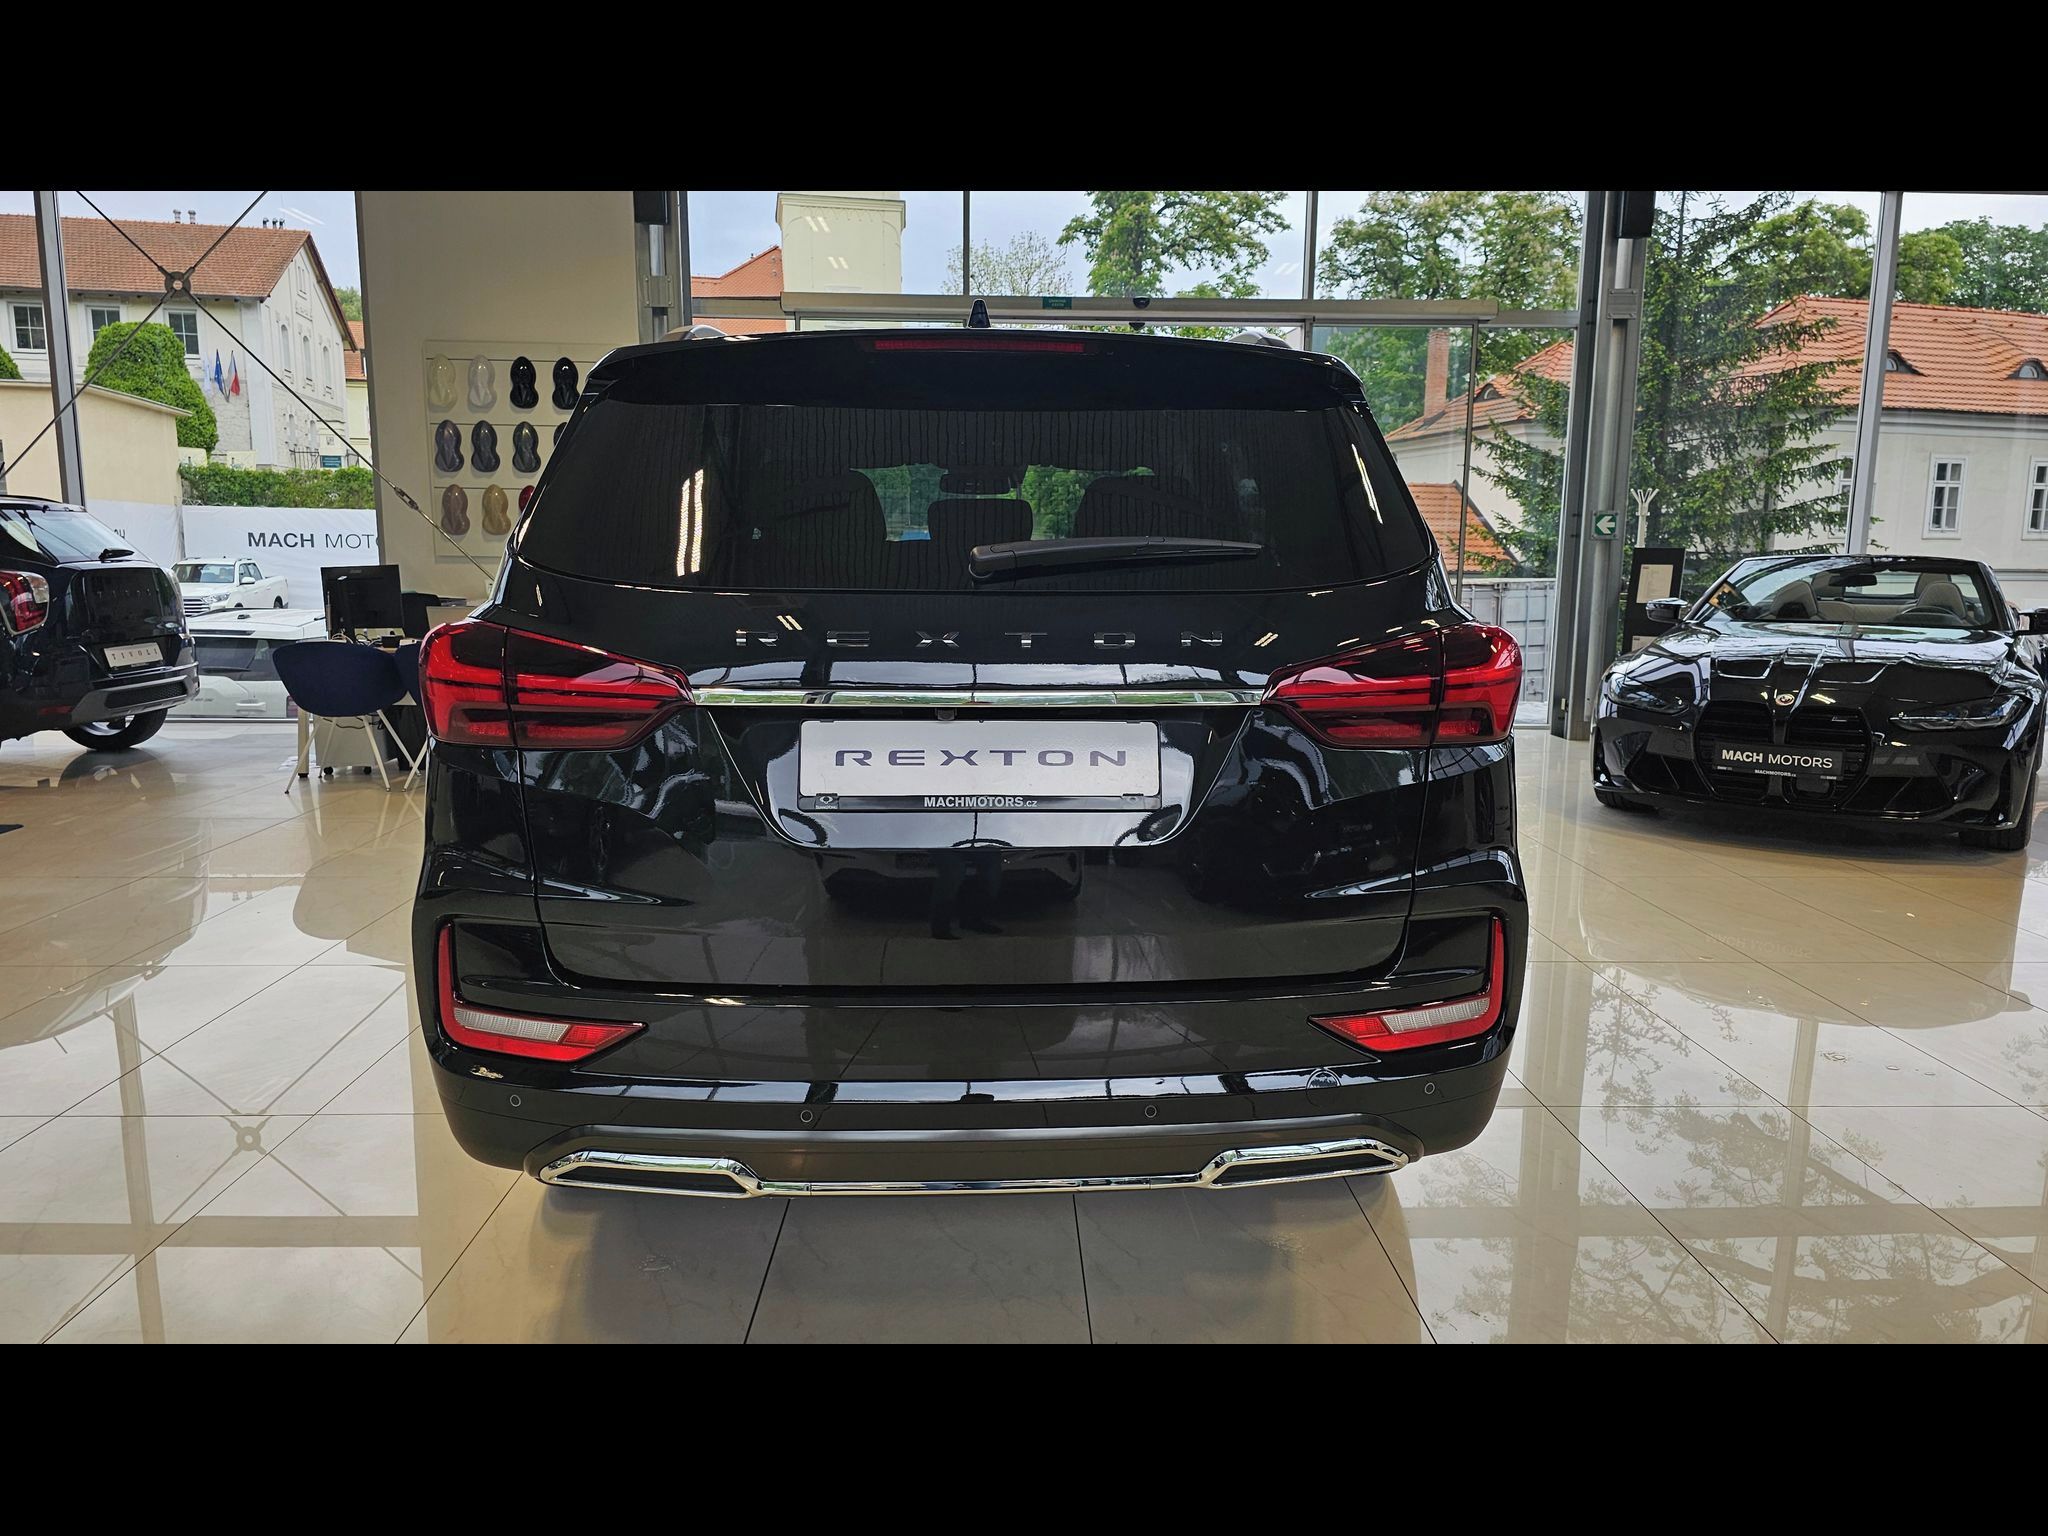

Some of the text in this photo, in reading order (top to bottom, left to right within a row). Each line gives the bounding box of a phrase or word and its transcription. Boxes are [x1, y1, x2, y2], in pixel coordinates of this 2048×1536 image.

[247, 532, 379, 549] MACH MOT
[735, 629, 1223, 648] REXTON
[835, 749, 1127, 767] REXTON
[1721, 749, 1833, 769] MACH MOTORS
[923, 796, 1038, 808] MACHMOTORS.cz
